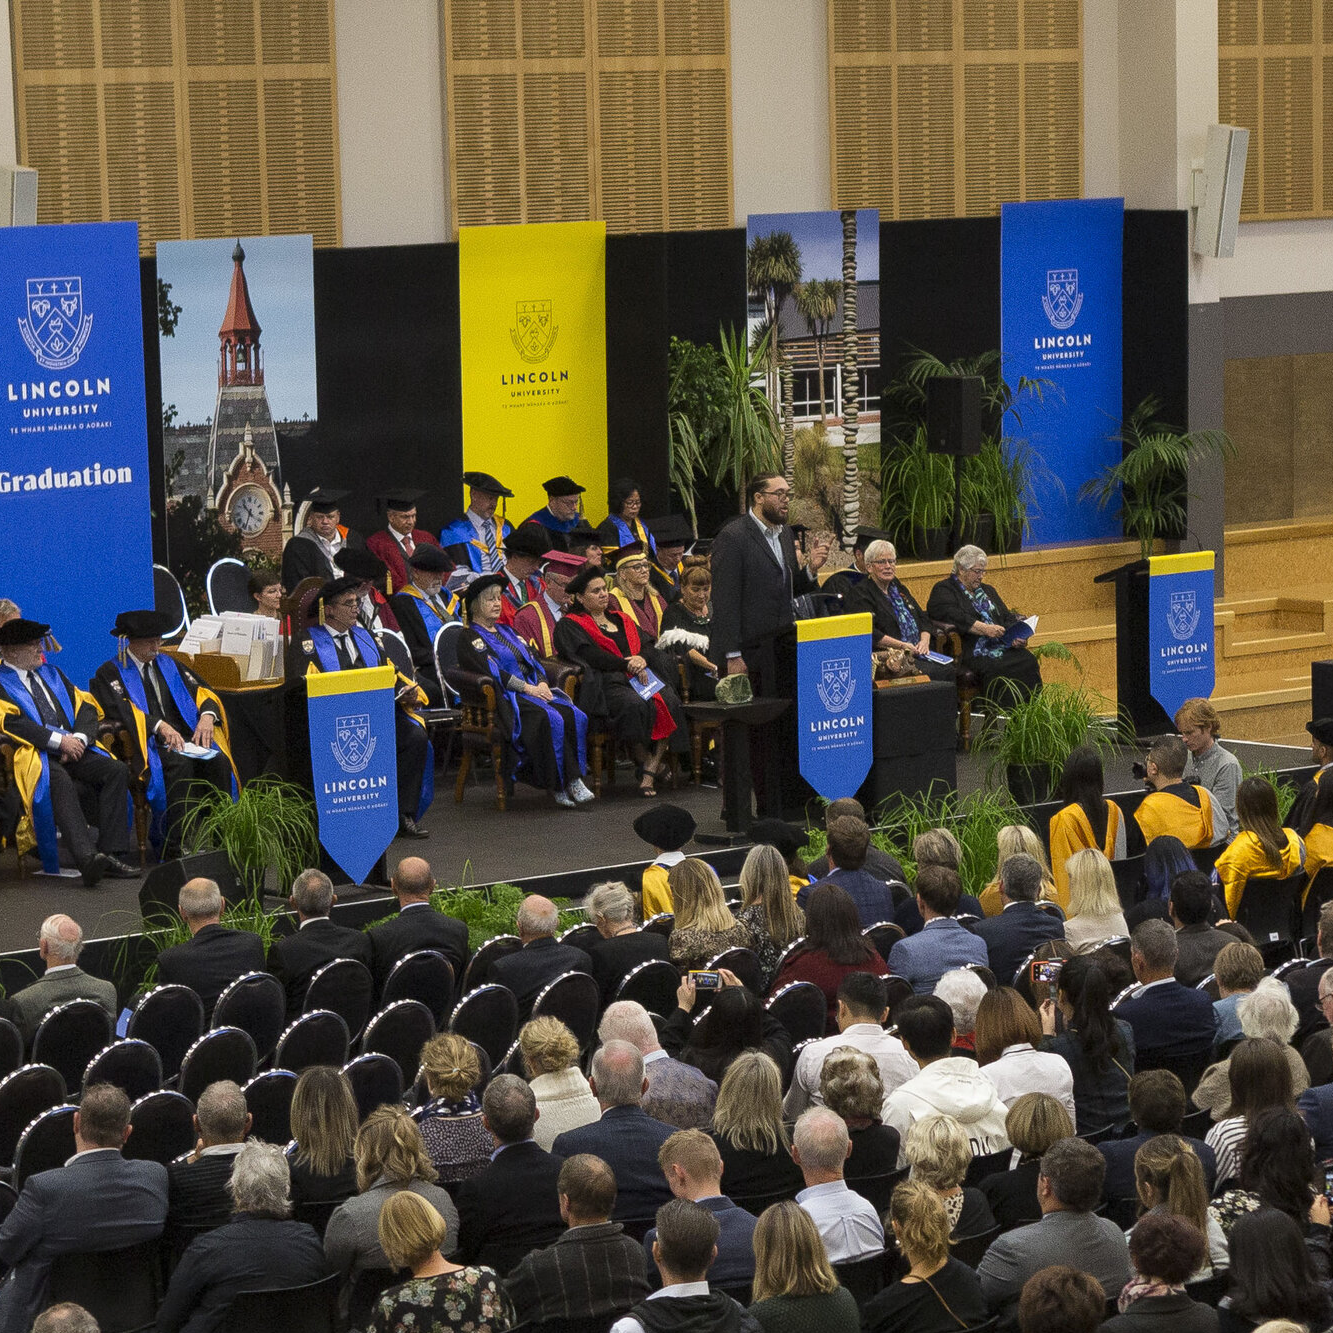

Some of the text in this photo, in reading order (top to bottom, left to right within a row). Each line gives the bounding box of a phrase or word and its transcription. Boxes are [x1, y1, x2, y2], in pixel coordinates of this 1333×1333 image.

[1034, 334, 1092, 349] LINCOLN
[1042, 350, 1085, 360] UNIVERSITY
[502, 370, 568, 385] LINCOLN
[8, 377, 110, 401] LINCOLN
[511, 388, 560, 397] UNIVERSITY
[23, 404, 98, 418] UNIVERSITY
[1161, 643, 1207, 657] LINCOLN
[1167, 657, 1201, 666] UNIVERSITY
[810, 715, 864, 732] LINCOLN
[818, 731, 858, 741] UNIVERSITY
[324, 776, 387, 794] LINCOLN
[332, 792, 380, 804] UNIVERSITY
